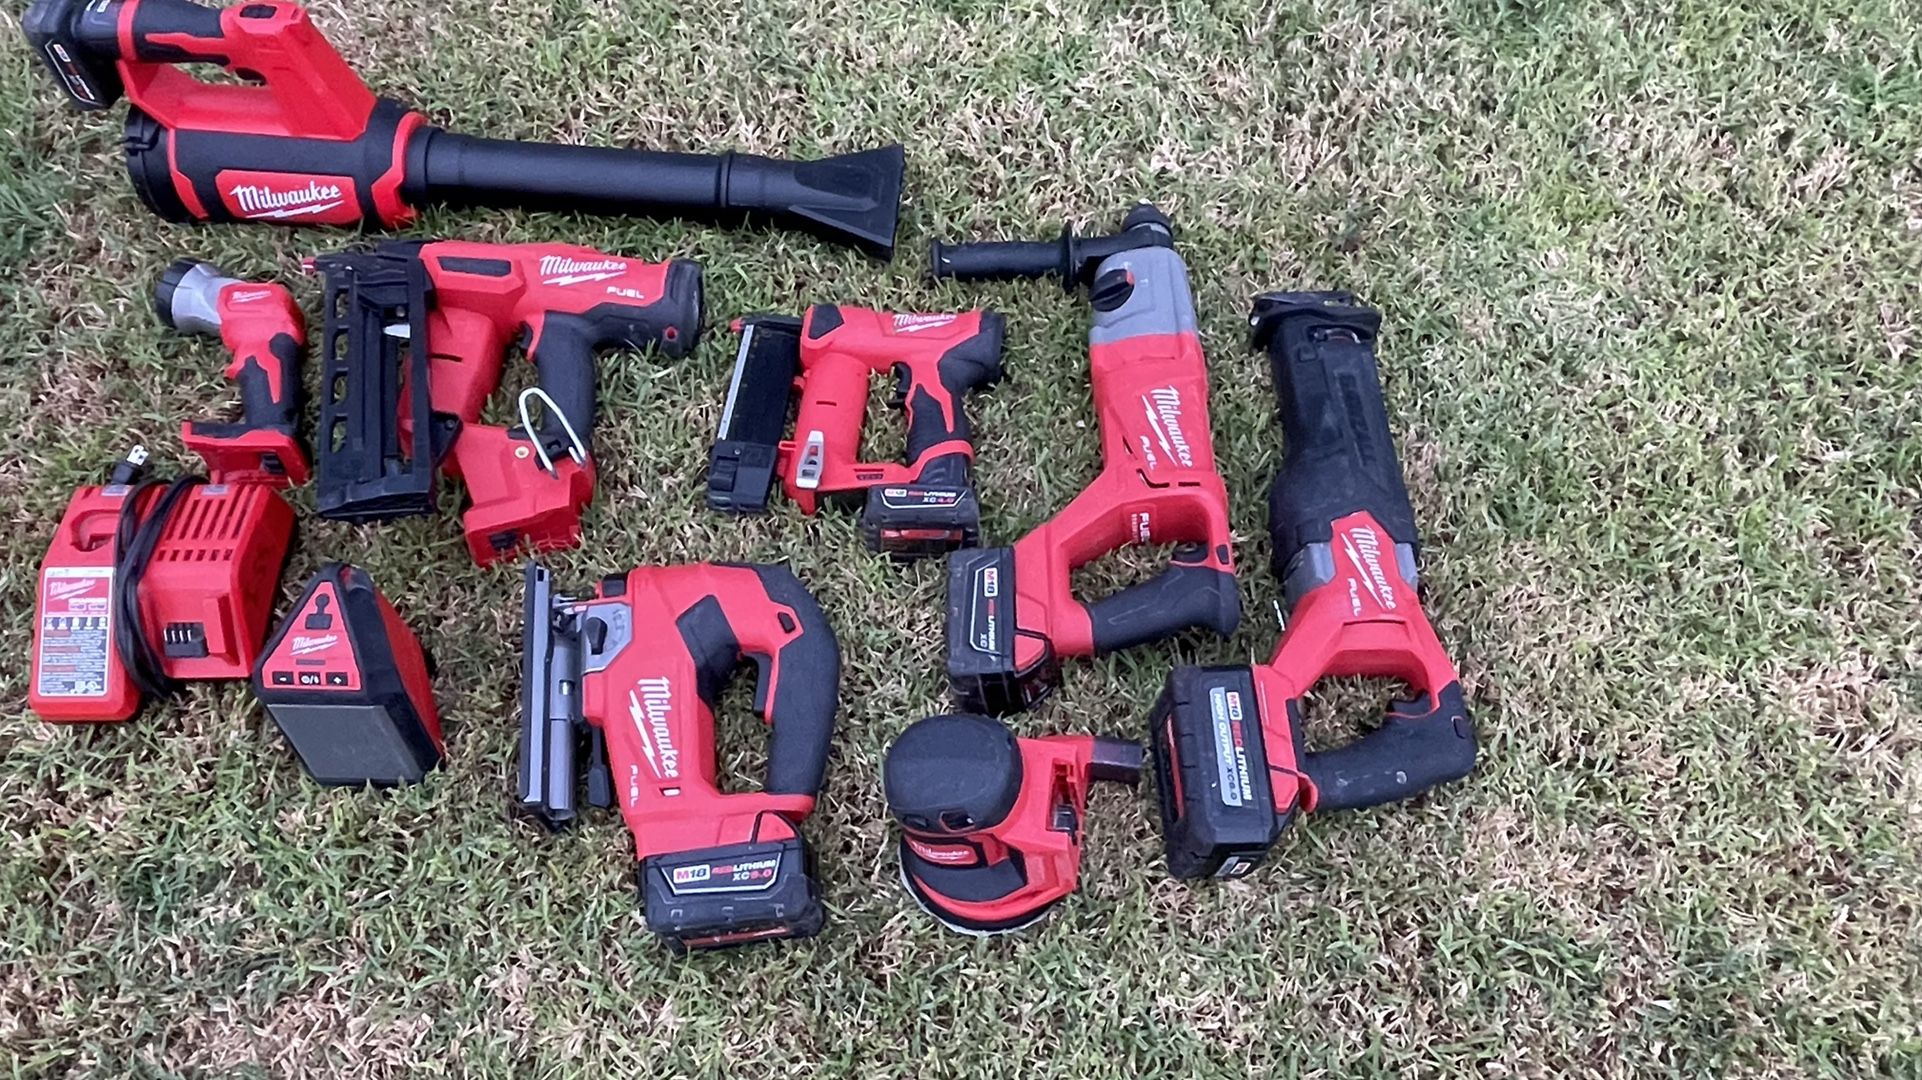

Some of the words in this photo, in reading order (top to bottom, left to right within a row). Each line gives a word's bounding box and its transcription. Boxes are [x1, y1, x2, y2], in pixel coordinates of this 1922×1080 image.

[229, 180, 342, 212] Milwaukee
[540, 254, 628, 276] Milwaukee
[606, 286, 645, 299] FUEL
[1150, 385, 1193, 467] Milwaukee
[1140, 435, 1157, 470] FUEL
[1349, 523, 1396, 609] Milwaukee
[1347, 577, 1361, 617] FUEL
[637, 675, 679, 778] Milwaukee
[1219, 721, 1232, 765] OUTPUT
[675, 867, 707, 880] M18
